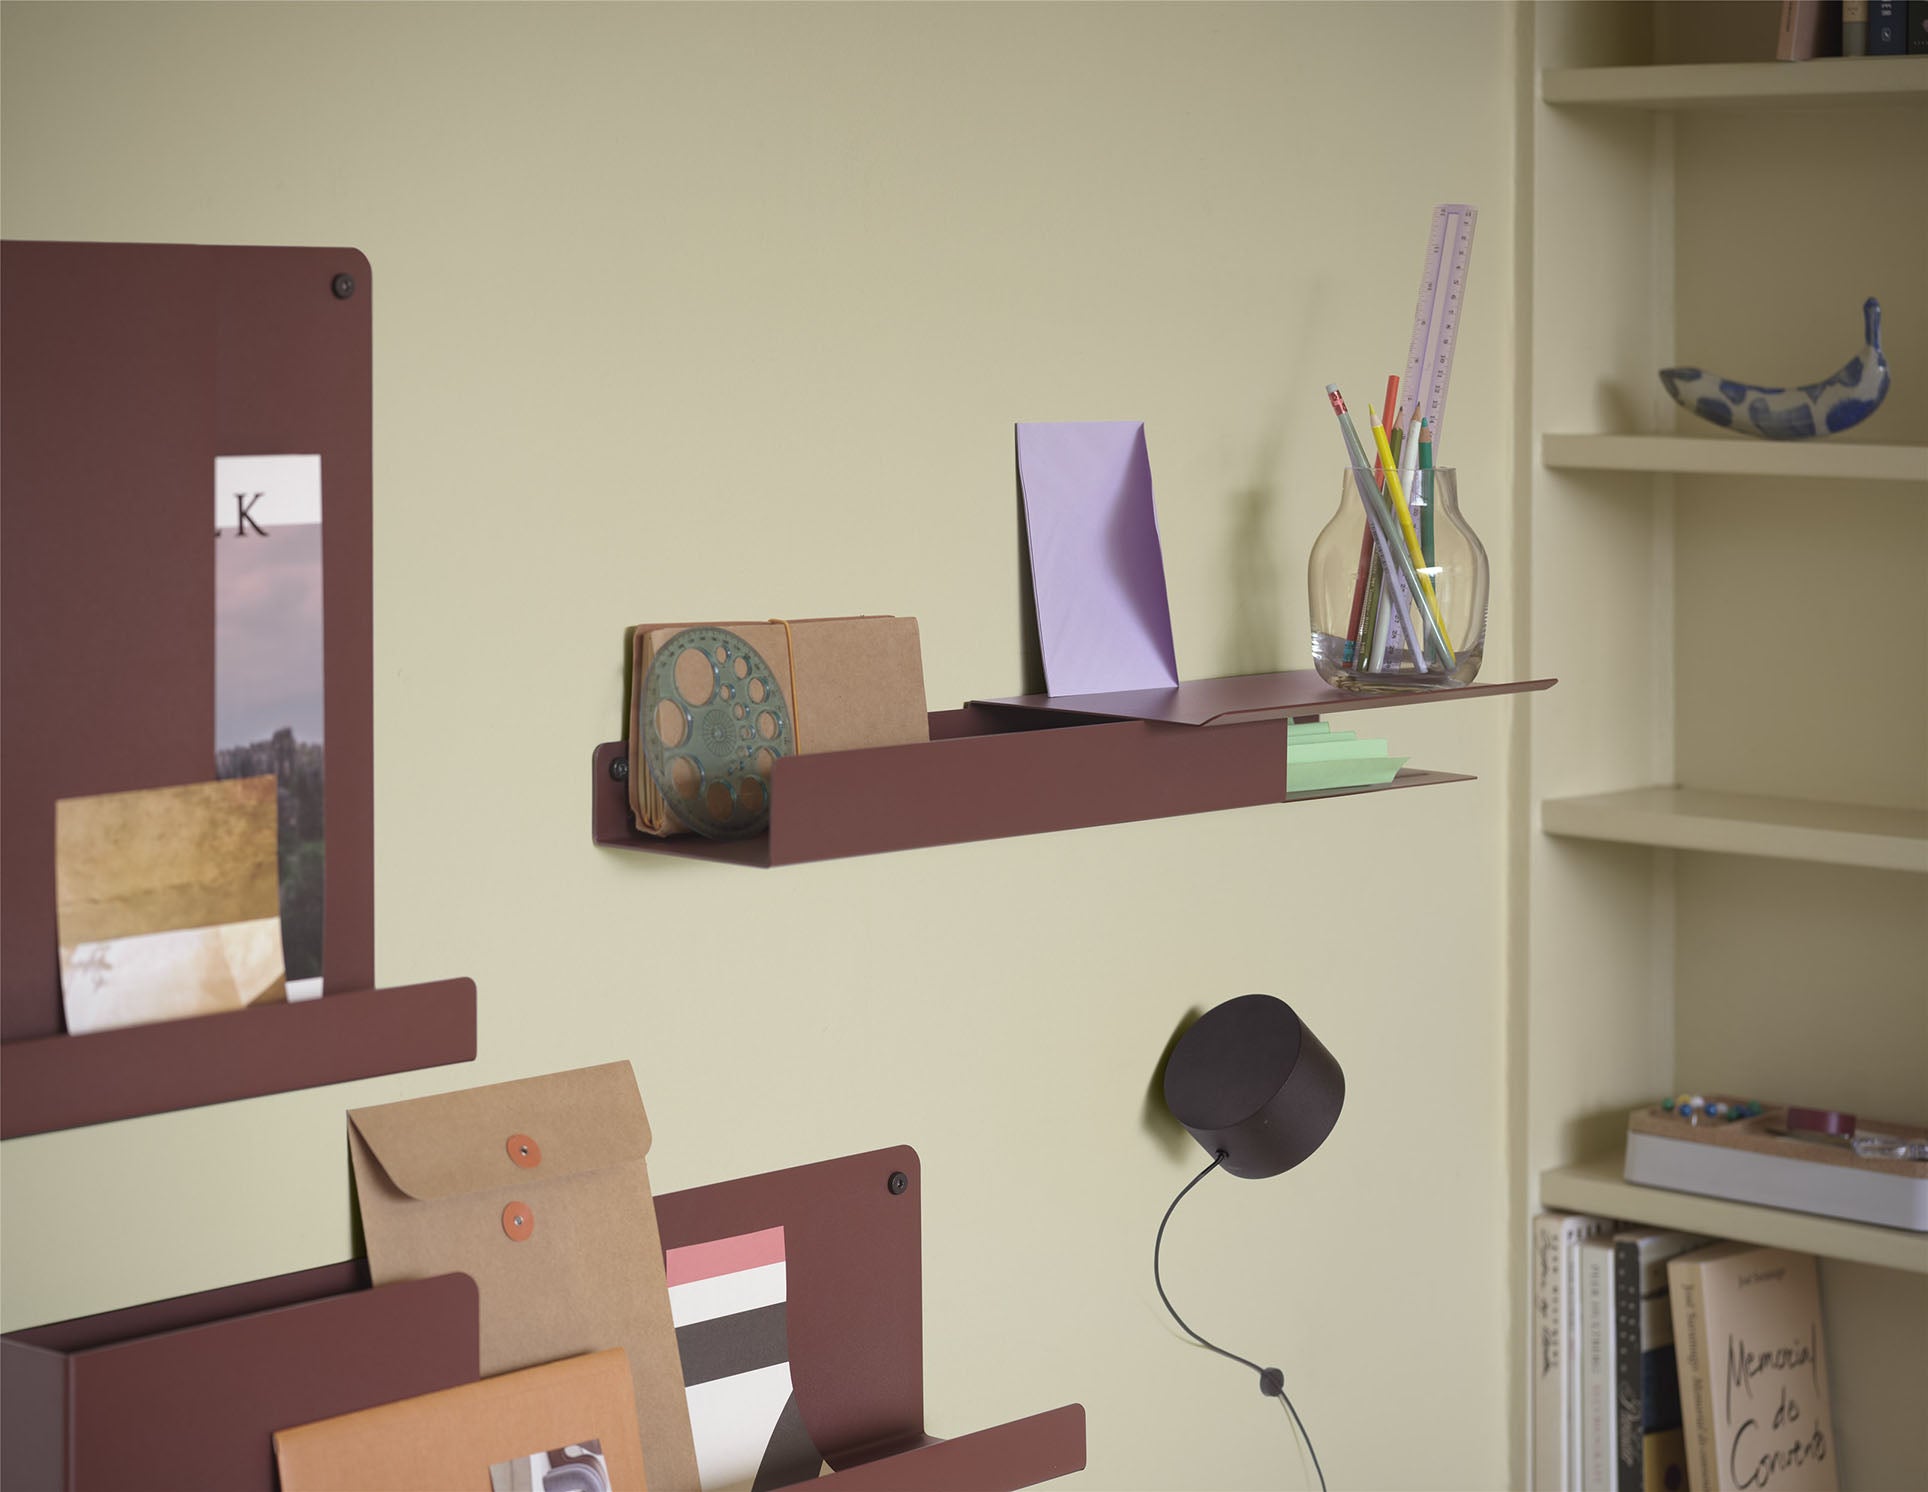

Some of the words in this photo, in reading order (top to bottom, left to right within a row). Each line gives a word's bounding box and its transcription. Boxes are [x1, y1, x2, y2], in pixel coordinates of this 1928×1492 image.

[215, 492, 269, 538] K
[1726, 1321, 1821, 1426] Memorial
[1773, 1384, 1799, 1430] do
[1731, 1417, 1827, 1490] Convento
